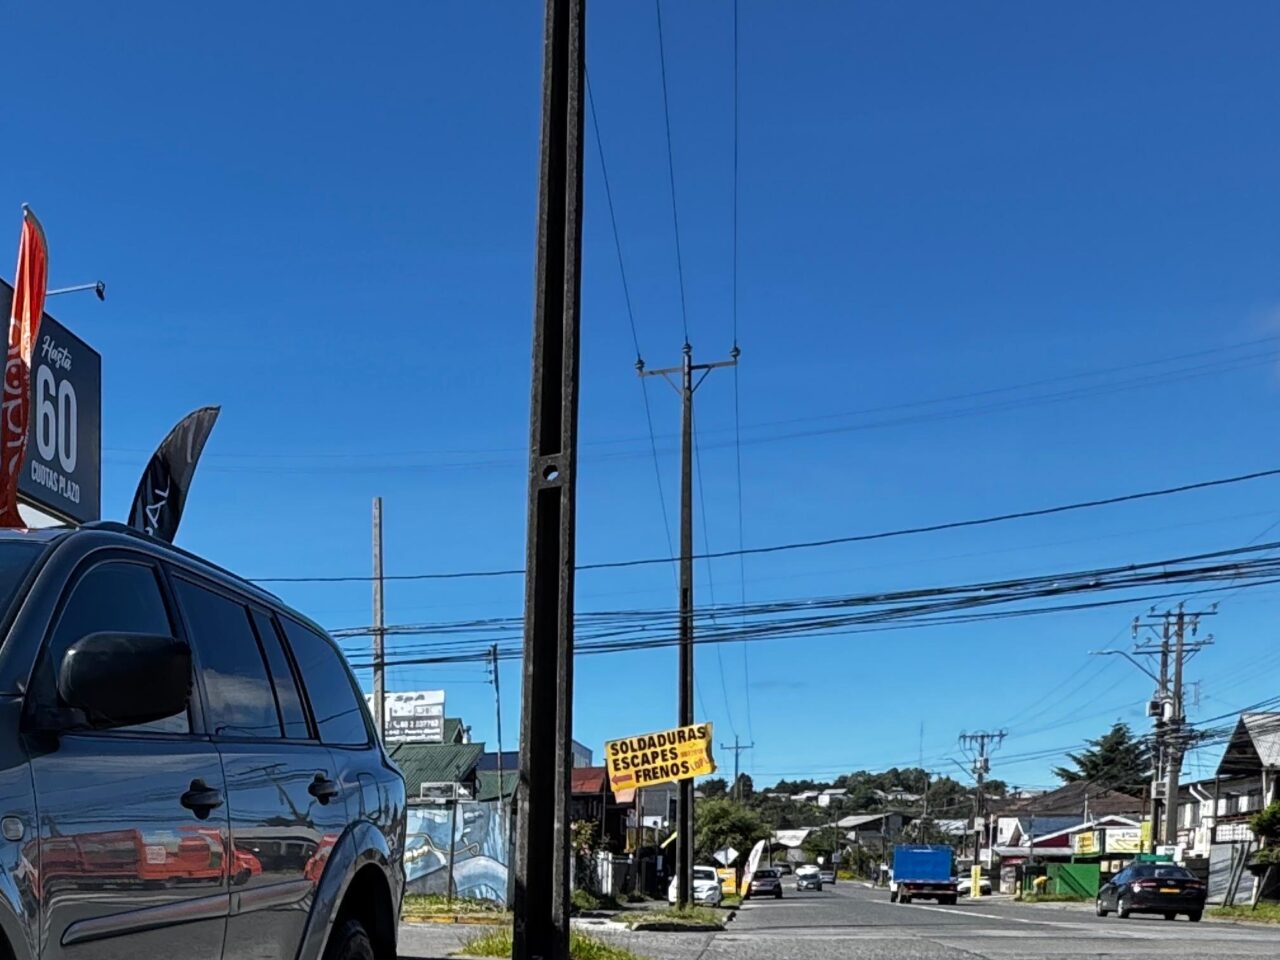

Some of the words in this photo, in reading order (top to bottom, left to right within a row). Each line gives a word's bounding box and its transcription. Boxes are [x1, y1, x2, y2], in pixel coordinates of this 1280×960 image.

[41, 335, 73, 371] Hasta
[35, 364, 77, 473] 60
[31, 460, 58, 492] CUOTAS
[58, 476, 80, 503] PLAZO
[610, 726, 706, 757] SOLDADURAS
[612, 747, 678, 772] ESCAPES
[635, 760, 690, 783] FRENOS
